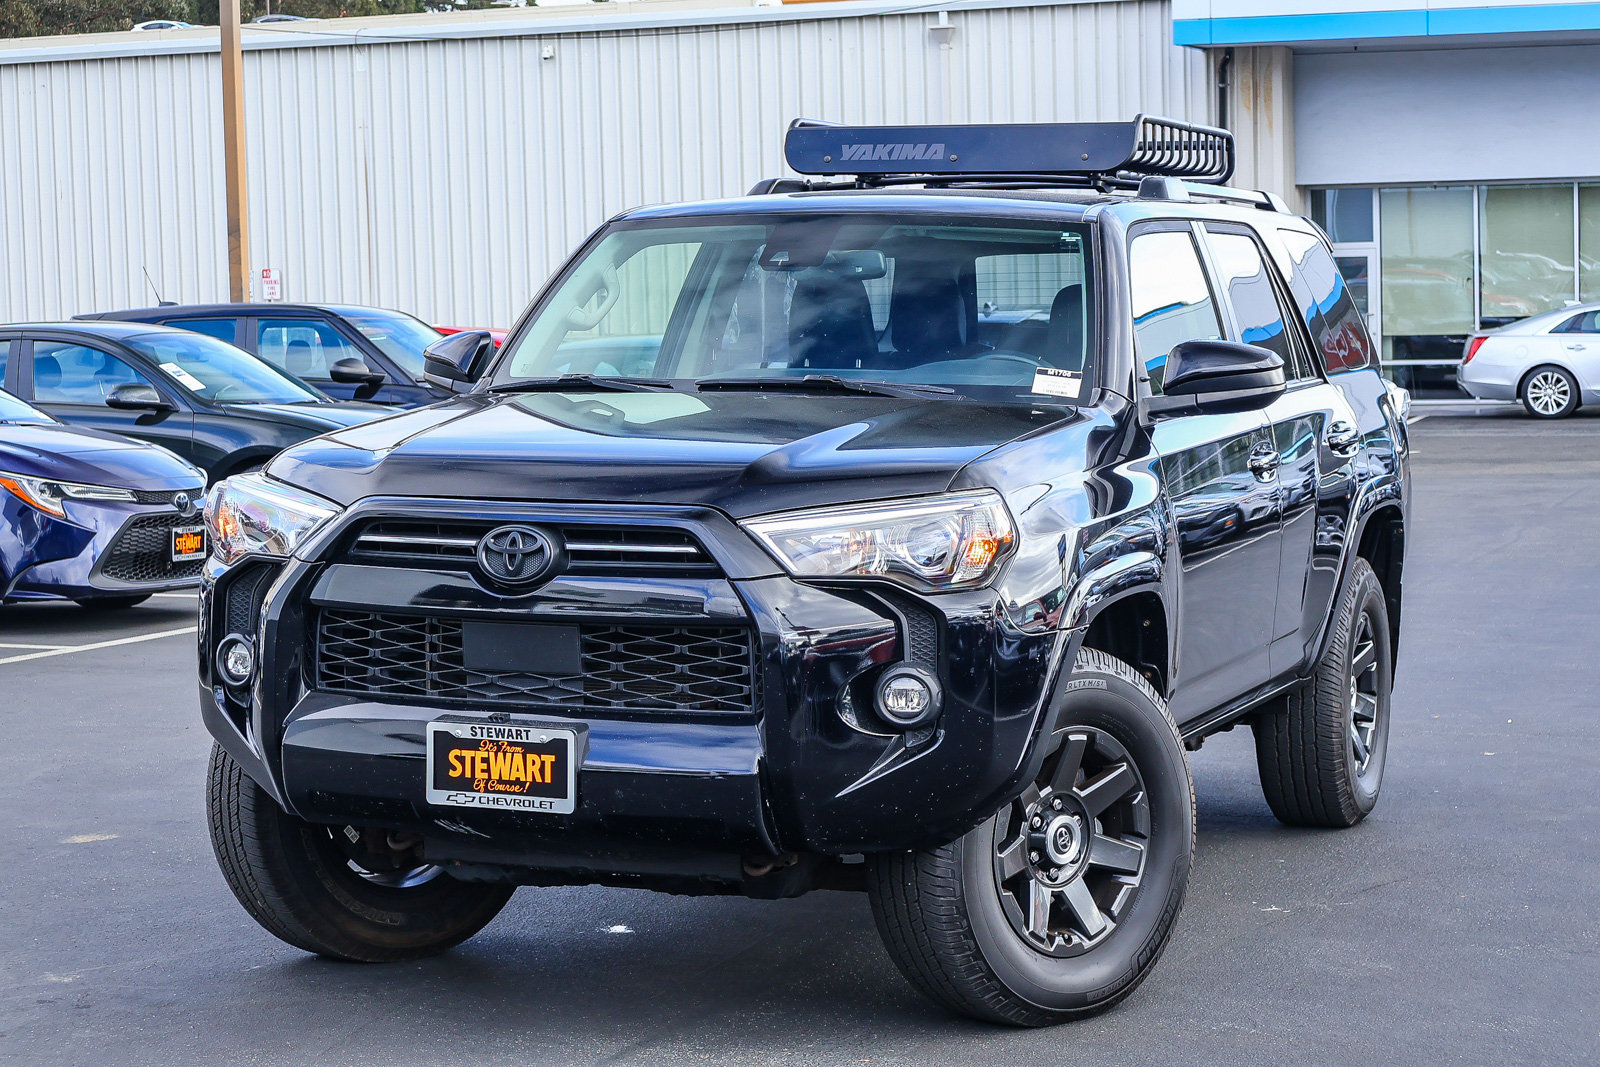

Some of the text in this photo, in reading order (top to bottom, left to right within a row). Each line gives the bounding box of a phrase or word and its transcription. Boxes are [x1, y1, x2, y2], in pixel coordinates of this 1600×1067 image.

[840, 143, 946, 161] YAKIMA
[175, 536, 202, 550] STEWART
[470, 725, 531, 741] STEWART
[479, 739, 525, 754] It's From
[448, 749, 556, 784] STEWART
[473, 778, 487, 793] Of
[478, 796, 555, 810] CHEVROLET
